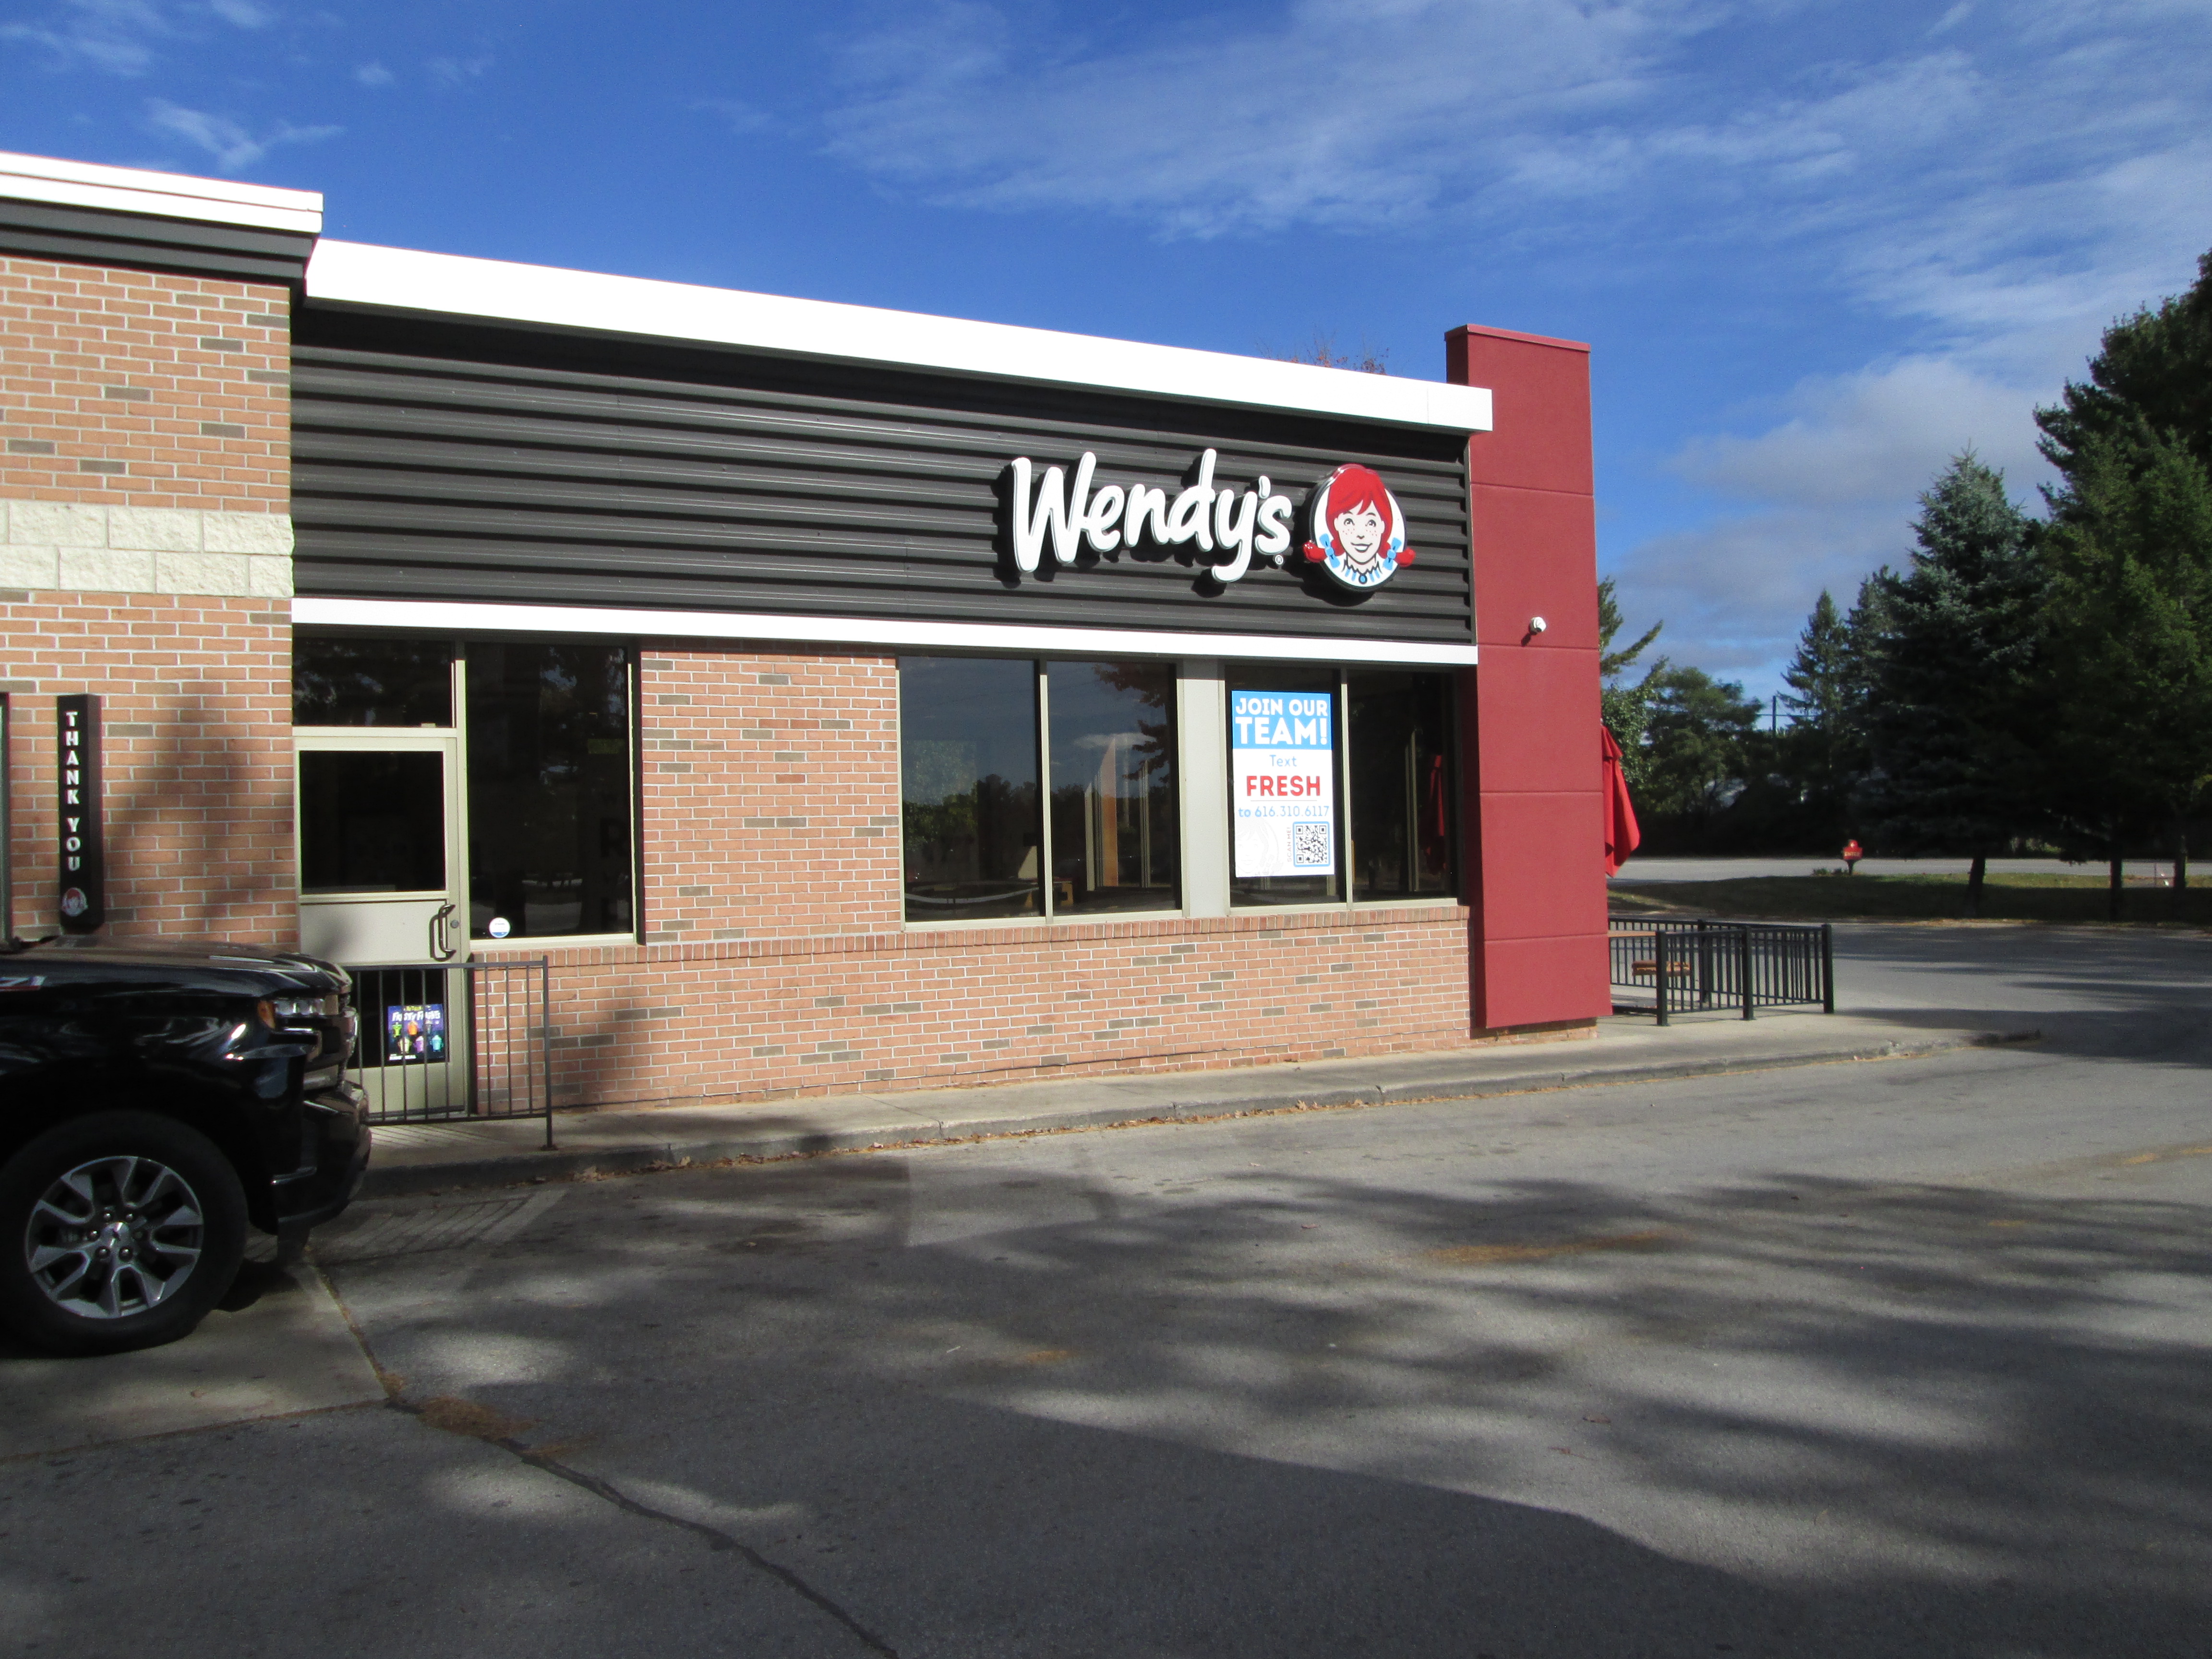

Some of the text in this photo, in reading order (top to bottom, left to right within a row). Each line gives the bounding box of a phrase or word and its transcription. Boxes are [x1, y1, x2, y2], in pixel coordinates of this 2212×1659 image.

[1011, 448, 1292, 582] Wendy's
[1235, 697, 1328, 716] JOIN OUR
[1235, 717, 1328, 745] TEAM!
[1269, 755, 1298, 767] Text
[65, 711, 81, 871] THANK YOU
[1246, 775, 1321, 797] FRESH
[1238, 805, 1330, 817] to 616.310.6117
